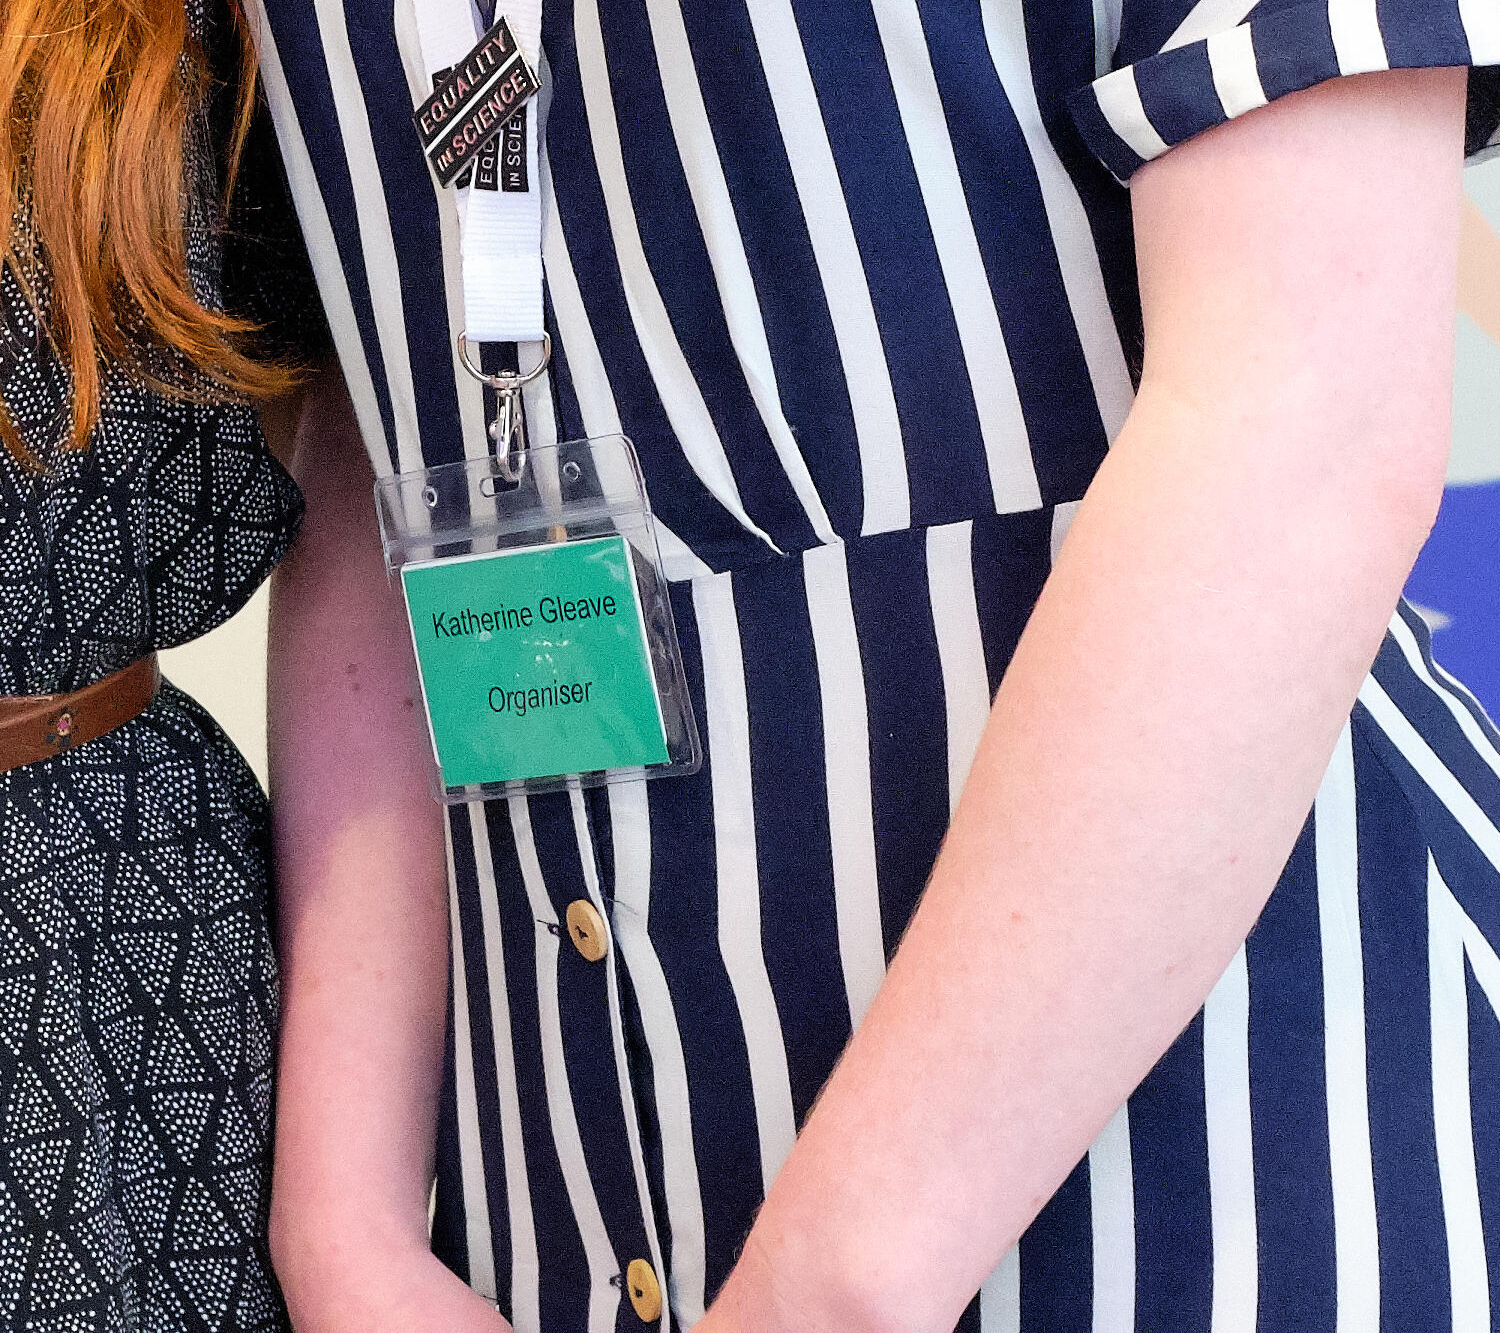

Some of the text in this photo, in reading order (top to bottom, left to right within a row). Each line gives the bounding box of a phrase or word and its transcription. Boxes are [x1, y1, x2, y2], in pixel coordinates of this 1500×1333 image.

[421, 29, 507, 134] EQUALITY
[437, 69, 527, 172] IN SCIENCE
[507, 117, 521, 187] IN SCIE
[432, 595, 616, 638] Katherine Gleave
[488, 679, 593, 717] Organiser
